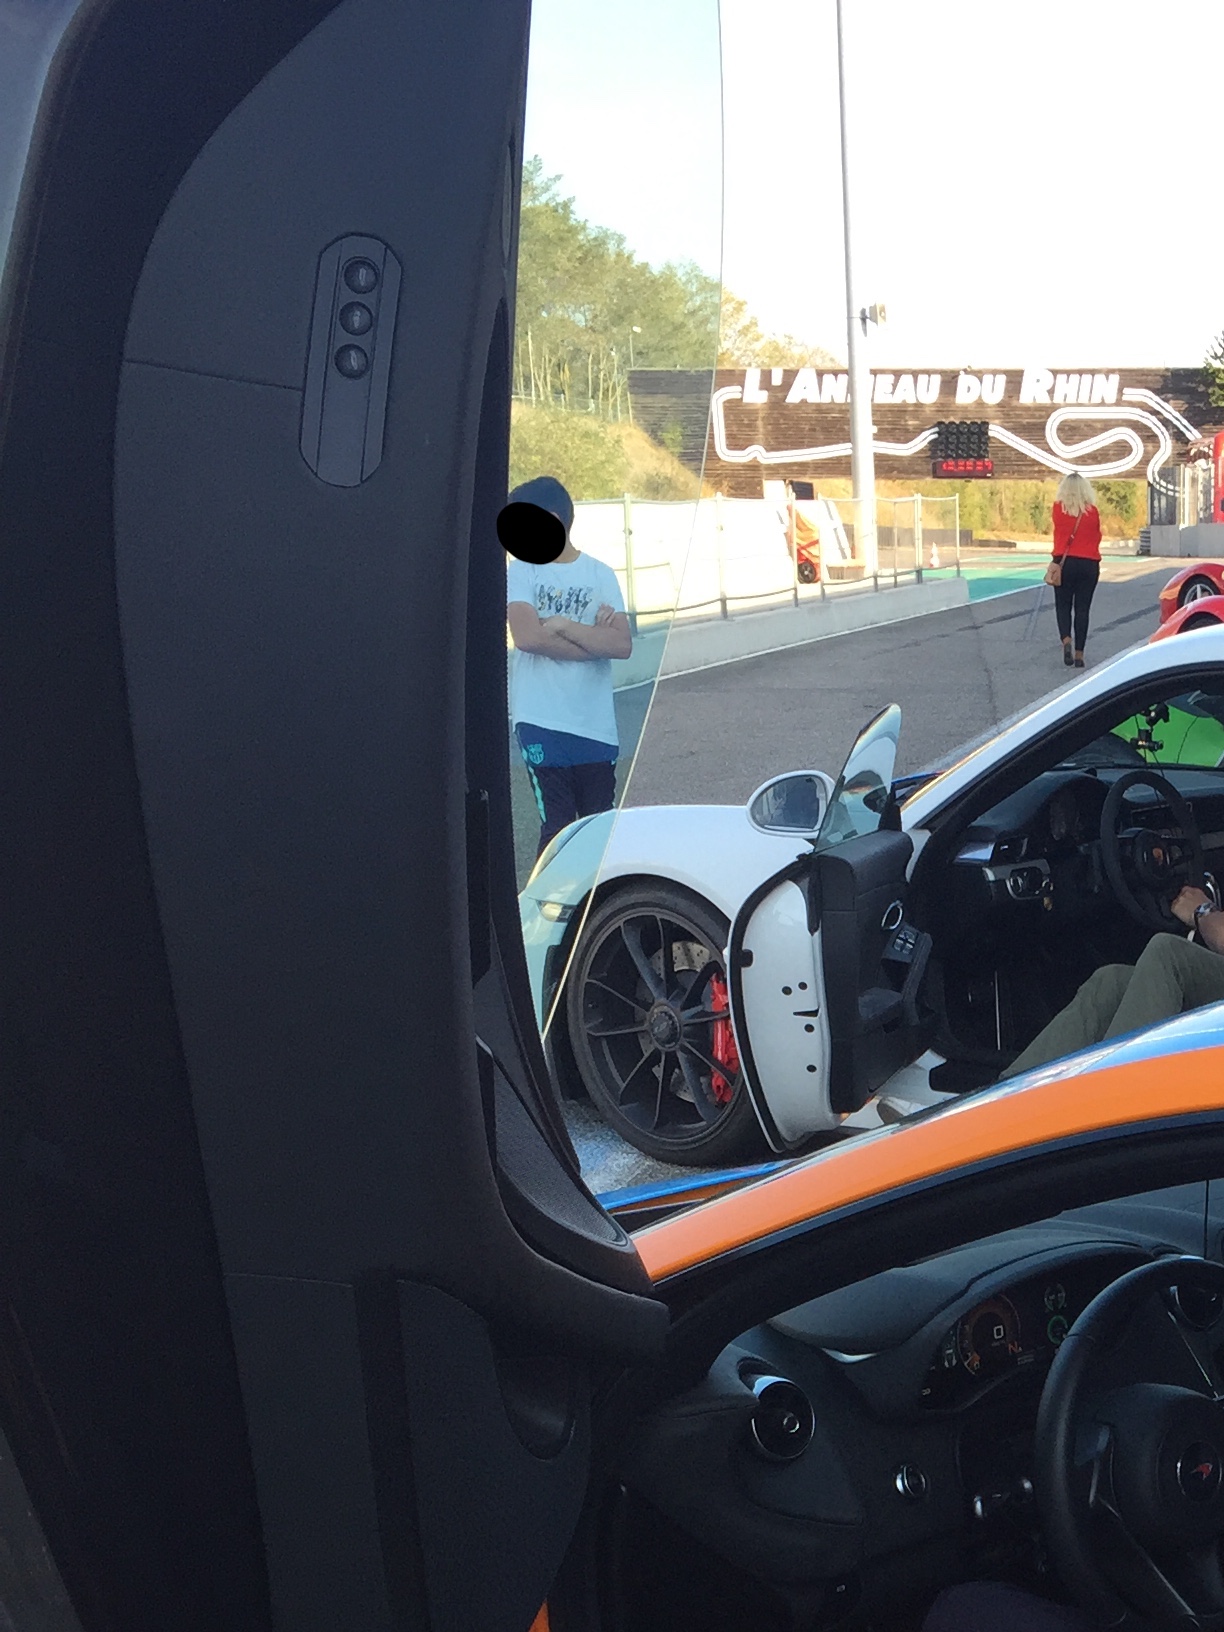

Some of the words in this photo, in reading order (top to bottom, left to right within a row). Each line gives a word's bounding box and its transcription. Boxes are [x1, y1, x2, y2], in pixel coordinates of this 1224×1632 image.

[742, 368, 942, 405] L'ANEAU
[955, 372, 1007, 405] DU
[1019, 368, 1121, 405] RHIN
